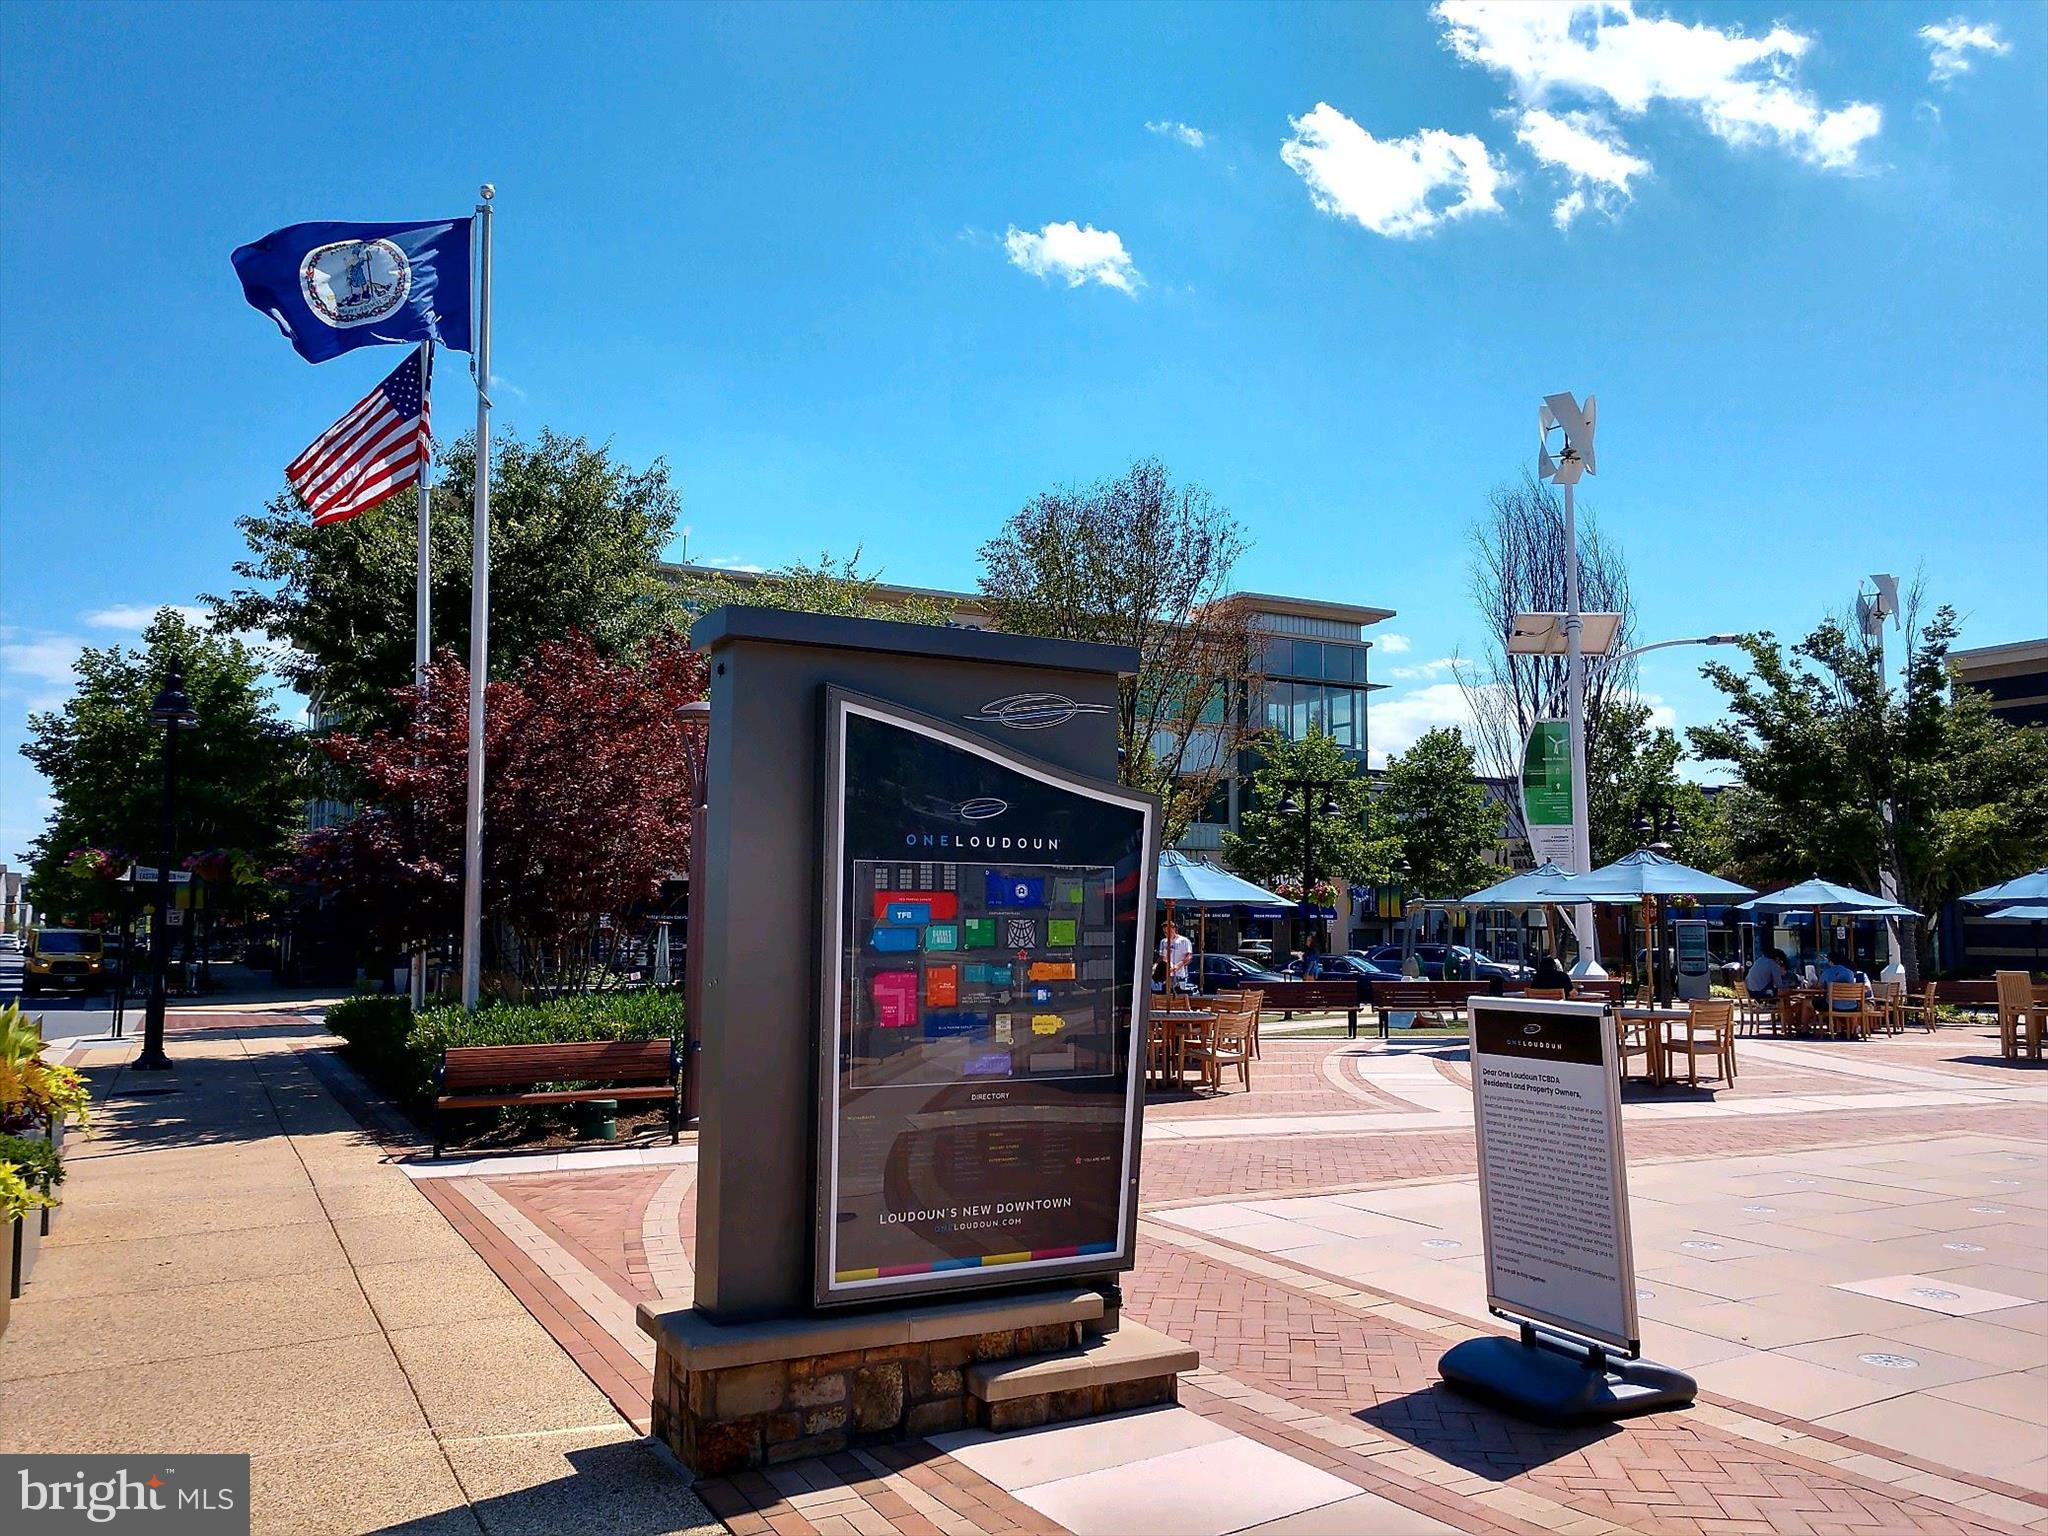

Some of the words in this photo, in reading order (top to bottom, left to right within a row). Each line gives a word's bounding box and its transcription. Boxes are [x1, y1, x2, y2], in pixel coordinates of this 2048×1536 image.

[906, 834, 1058, 850] ONELOUDOUN
[1482, 1068, 1497, 1076] Dear
[1511, 1071, 1537, 1081] Loudoun
[971, 1092, 1010, 1101] DIRECTORY
[1483, 1080, 1512, 1089] Residents
[1514, 1083, 1525, 1091] and
[1527, 1084, 1553, 1095] Property
[1554, 1088, 1582, 1099] Owners,
[879, 1208, 957, 1225] LOUDOUN'S
[962, 1204, 992, 1216] NEW
[996, 1197, 1072, 1214] DOWNTOWN
[934, 1218, 1022, 1233] ONELOUDOUN.COM
